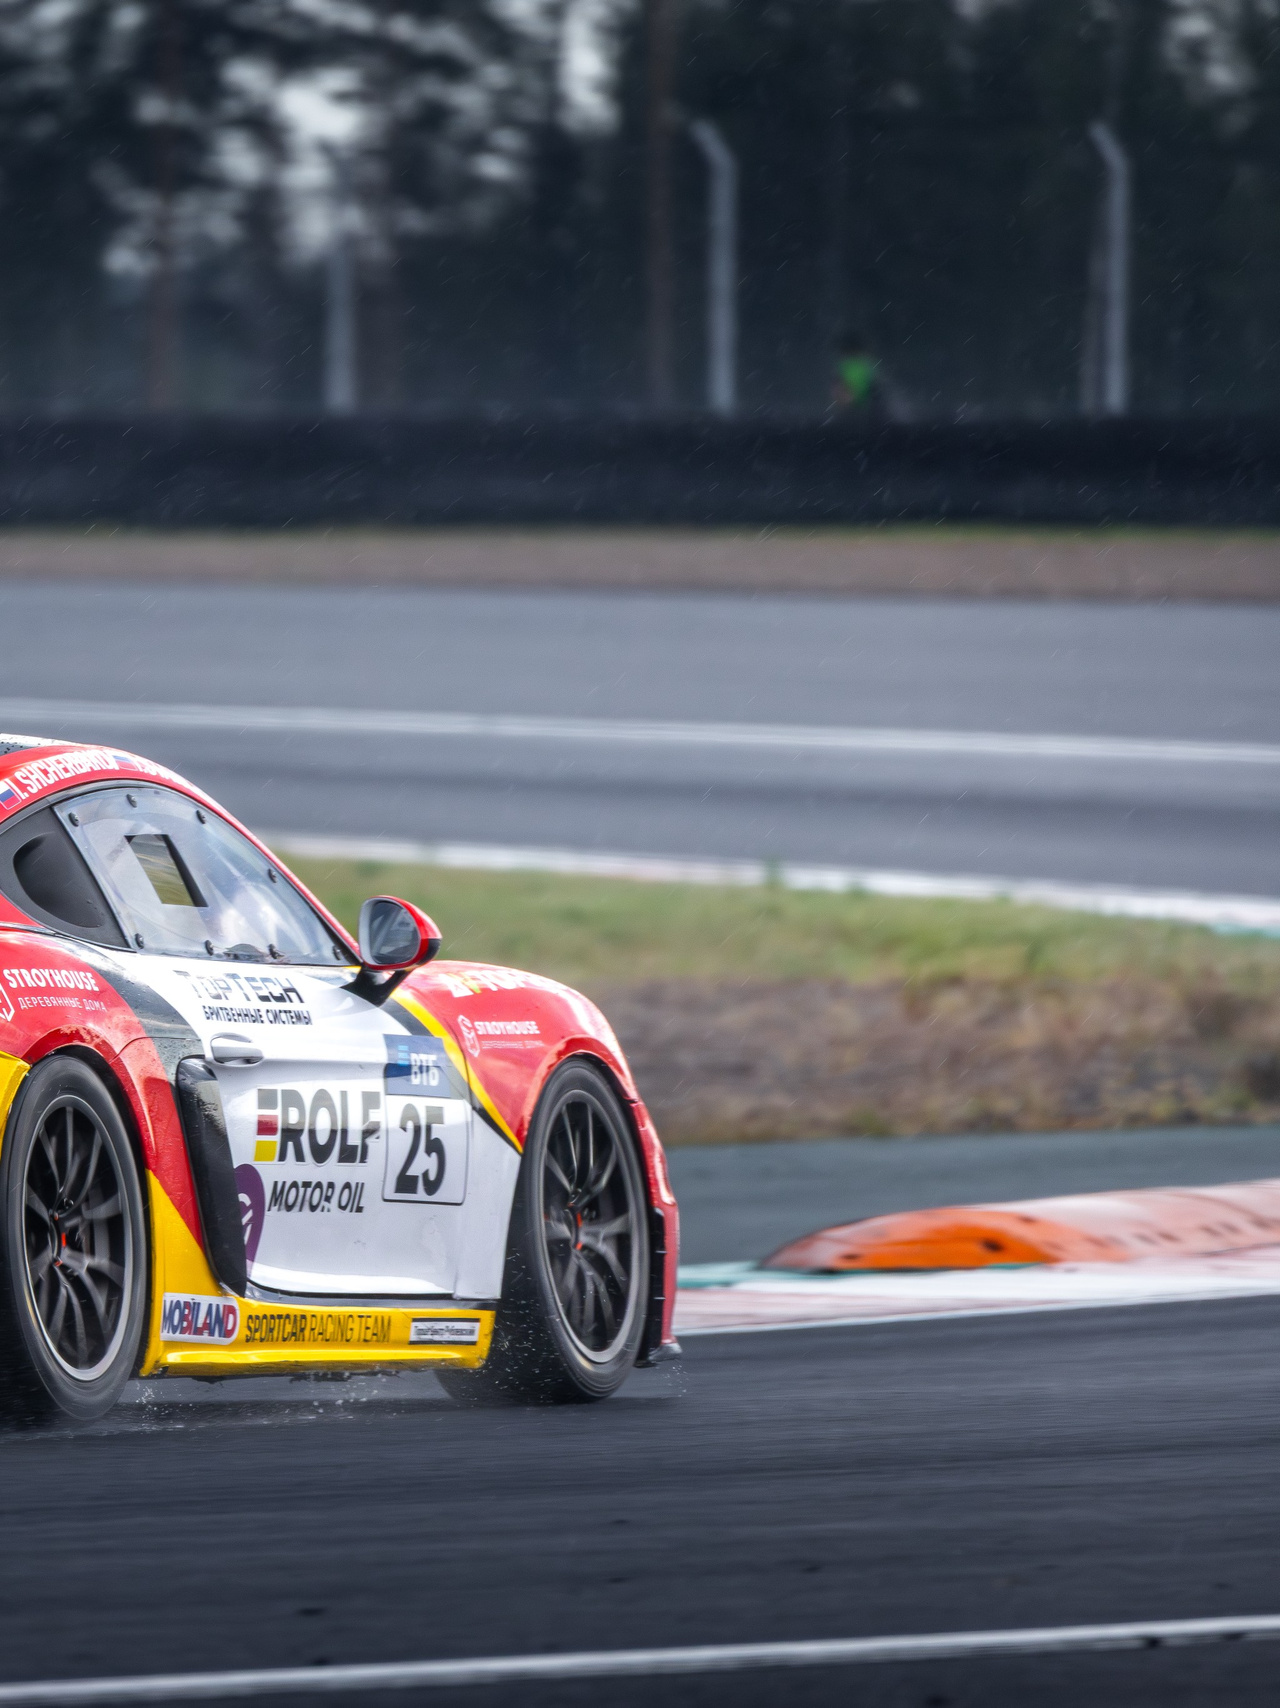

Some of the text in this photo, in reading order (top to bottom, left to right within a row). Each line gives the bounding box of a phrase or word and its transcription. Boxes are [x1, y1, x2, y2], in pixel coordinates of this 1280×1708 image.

[3, 967, 99, 992] STROYHOUSE
[17, 996, 107, 1012] ДЕРЕВЯННЫЕ ДОМА
[202, 1005, 313, 1025] БРИТВЕННЫЕ СИСТЕМЫ
[278, 1088, 381, 1164] ROLF
[395, 1103, 446, 1197] 25
[268, 1180, 365, 1214] MOTOR OIL
[161, 1299, 236, 1338] MOBILAND
[245, 1314, 392, 1343] SPORTCAR RACING TEAM
